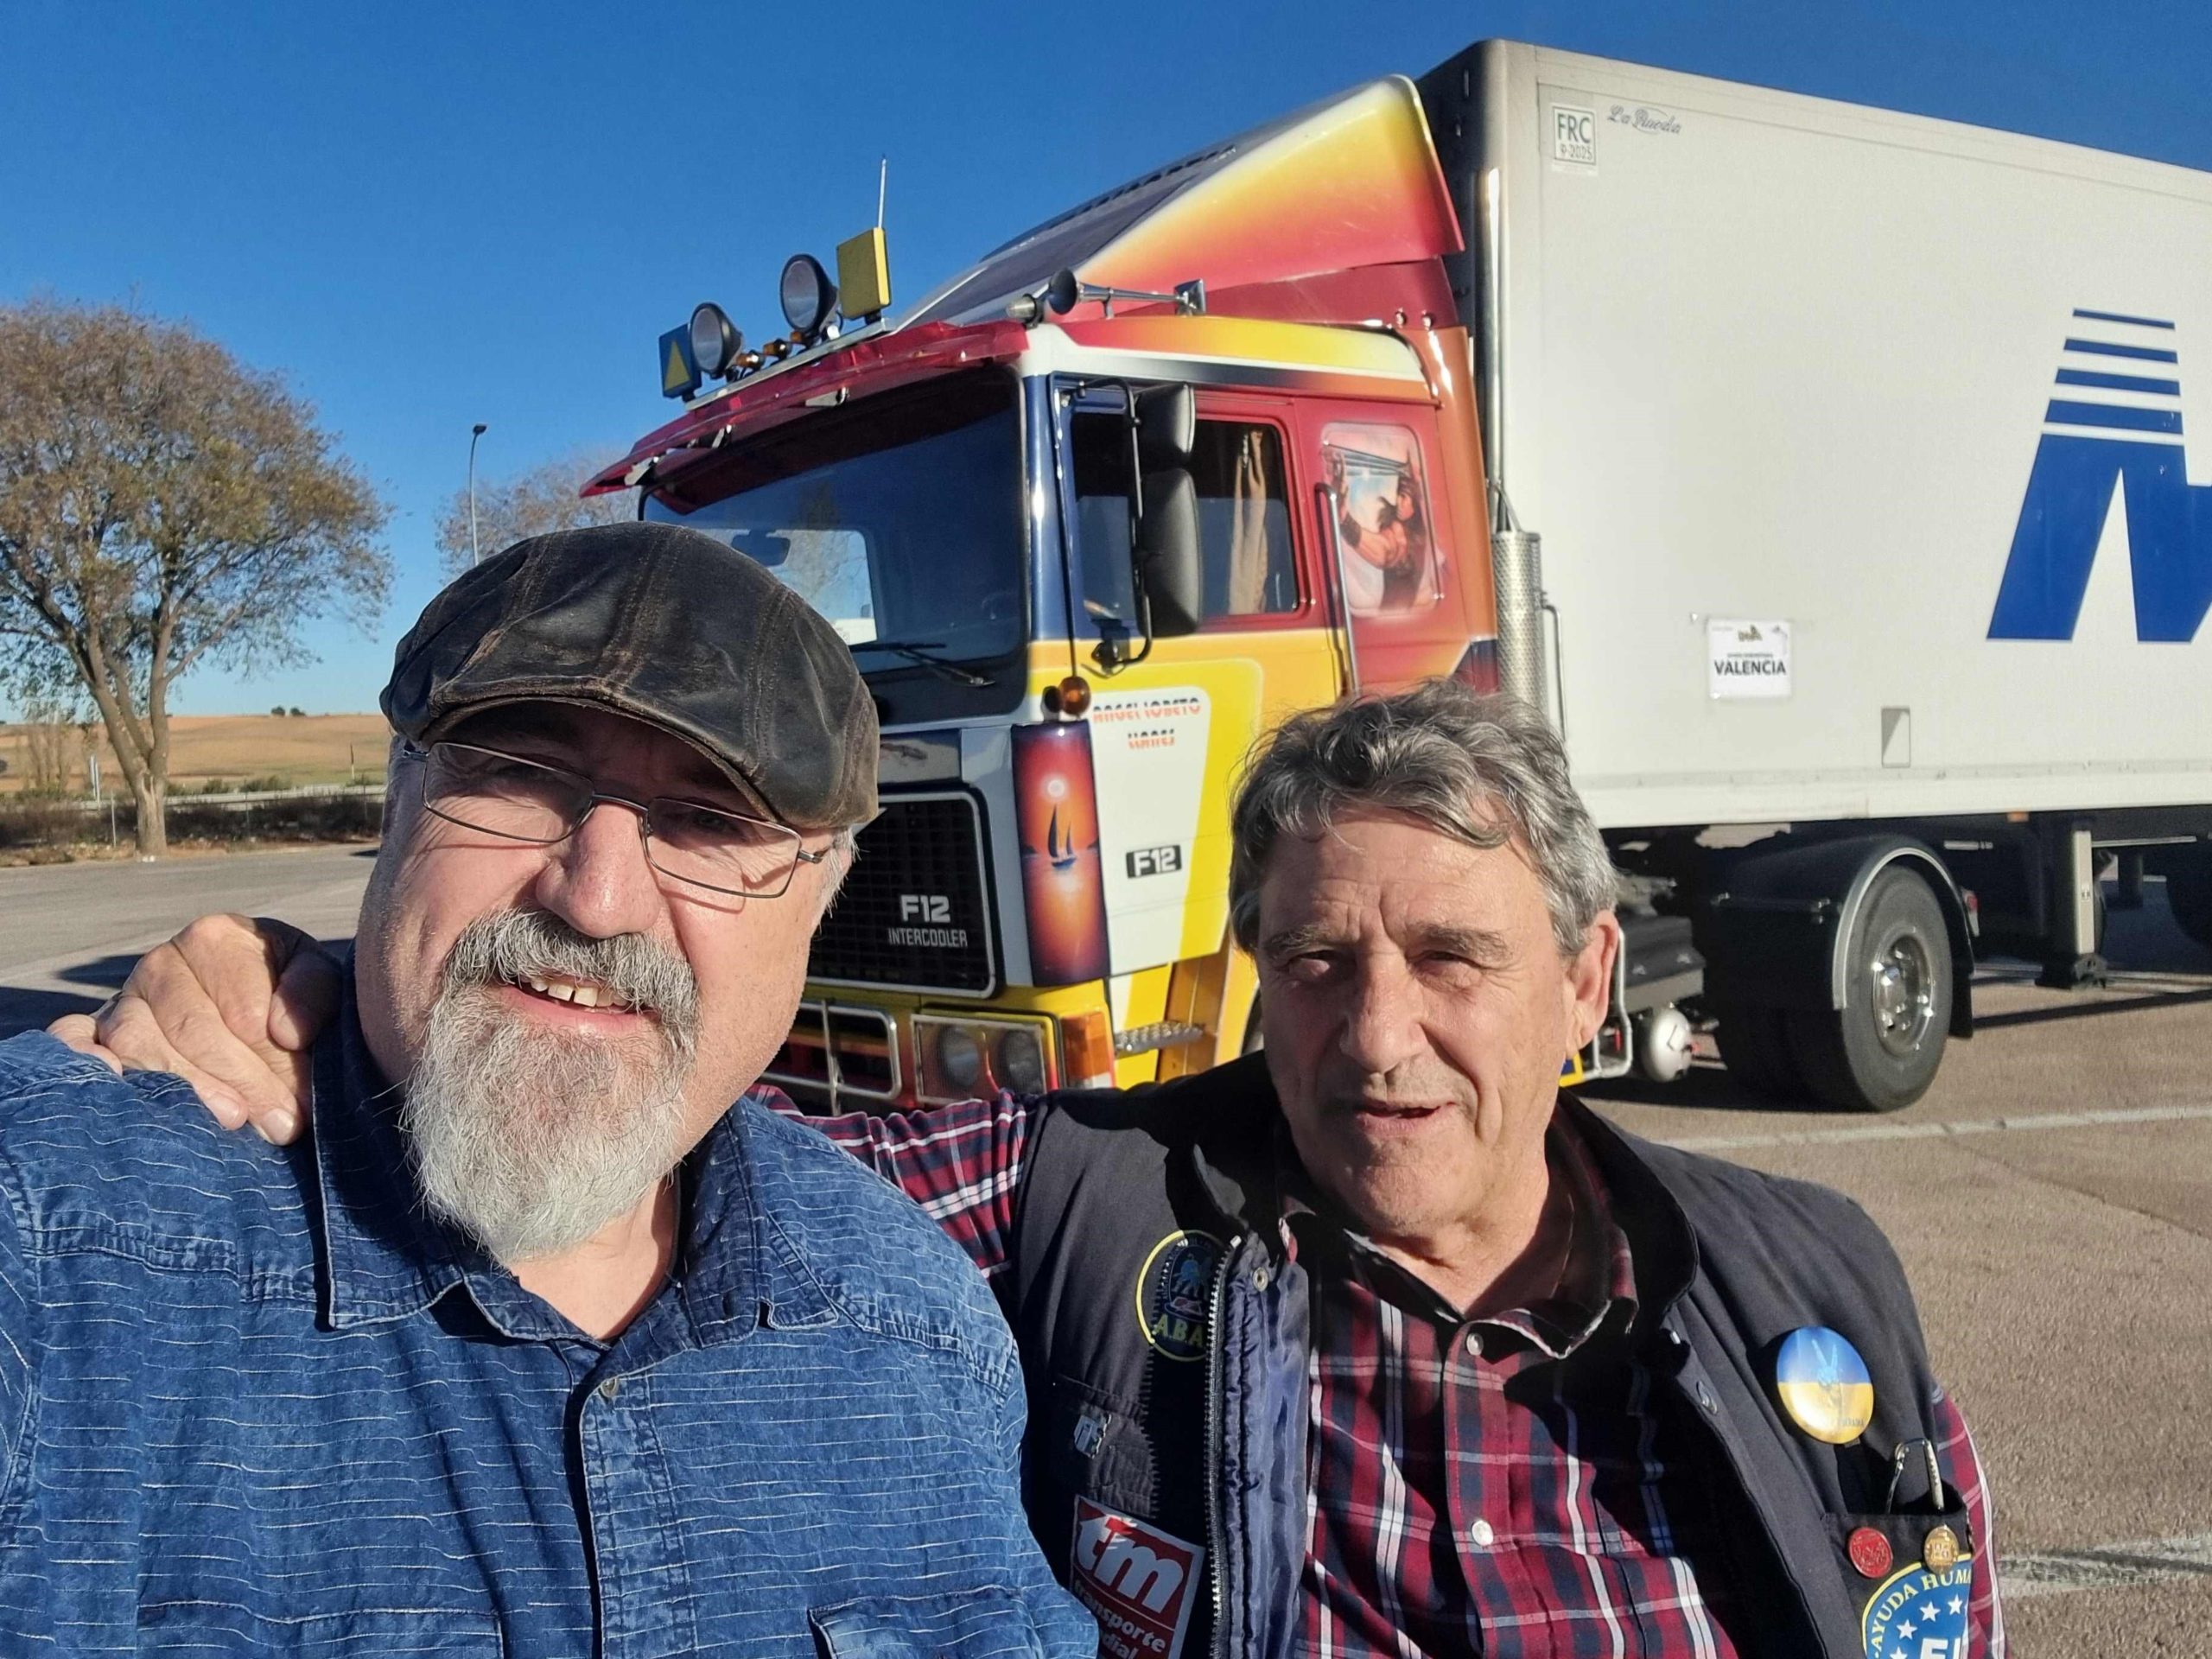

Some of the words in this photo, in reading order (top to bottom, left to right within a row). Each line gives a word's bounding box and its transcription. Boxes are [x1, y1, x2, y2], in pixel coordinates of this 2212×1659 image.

[1557, 112, 1591, 144] FRC
[1713, 659, 1787, 676] VALENCIA
[1133, 846, 1177, 878] F12
[900, 893, 951, 924] F12
[887, 926, 969, 949] INTERCOOLER
[1074, 1580, 1166, 1654] transporte
[1871, 1582, 1919, 1654] AYUDA
